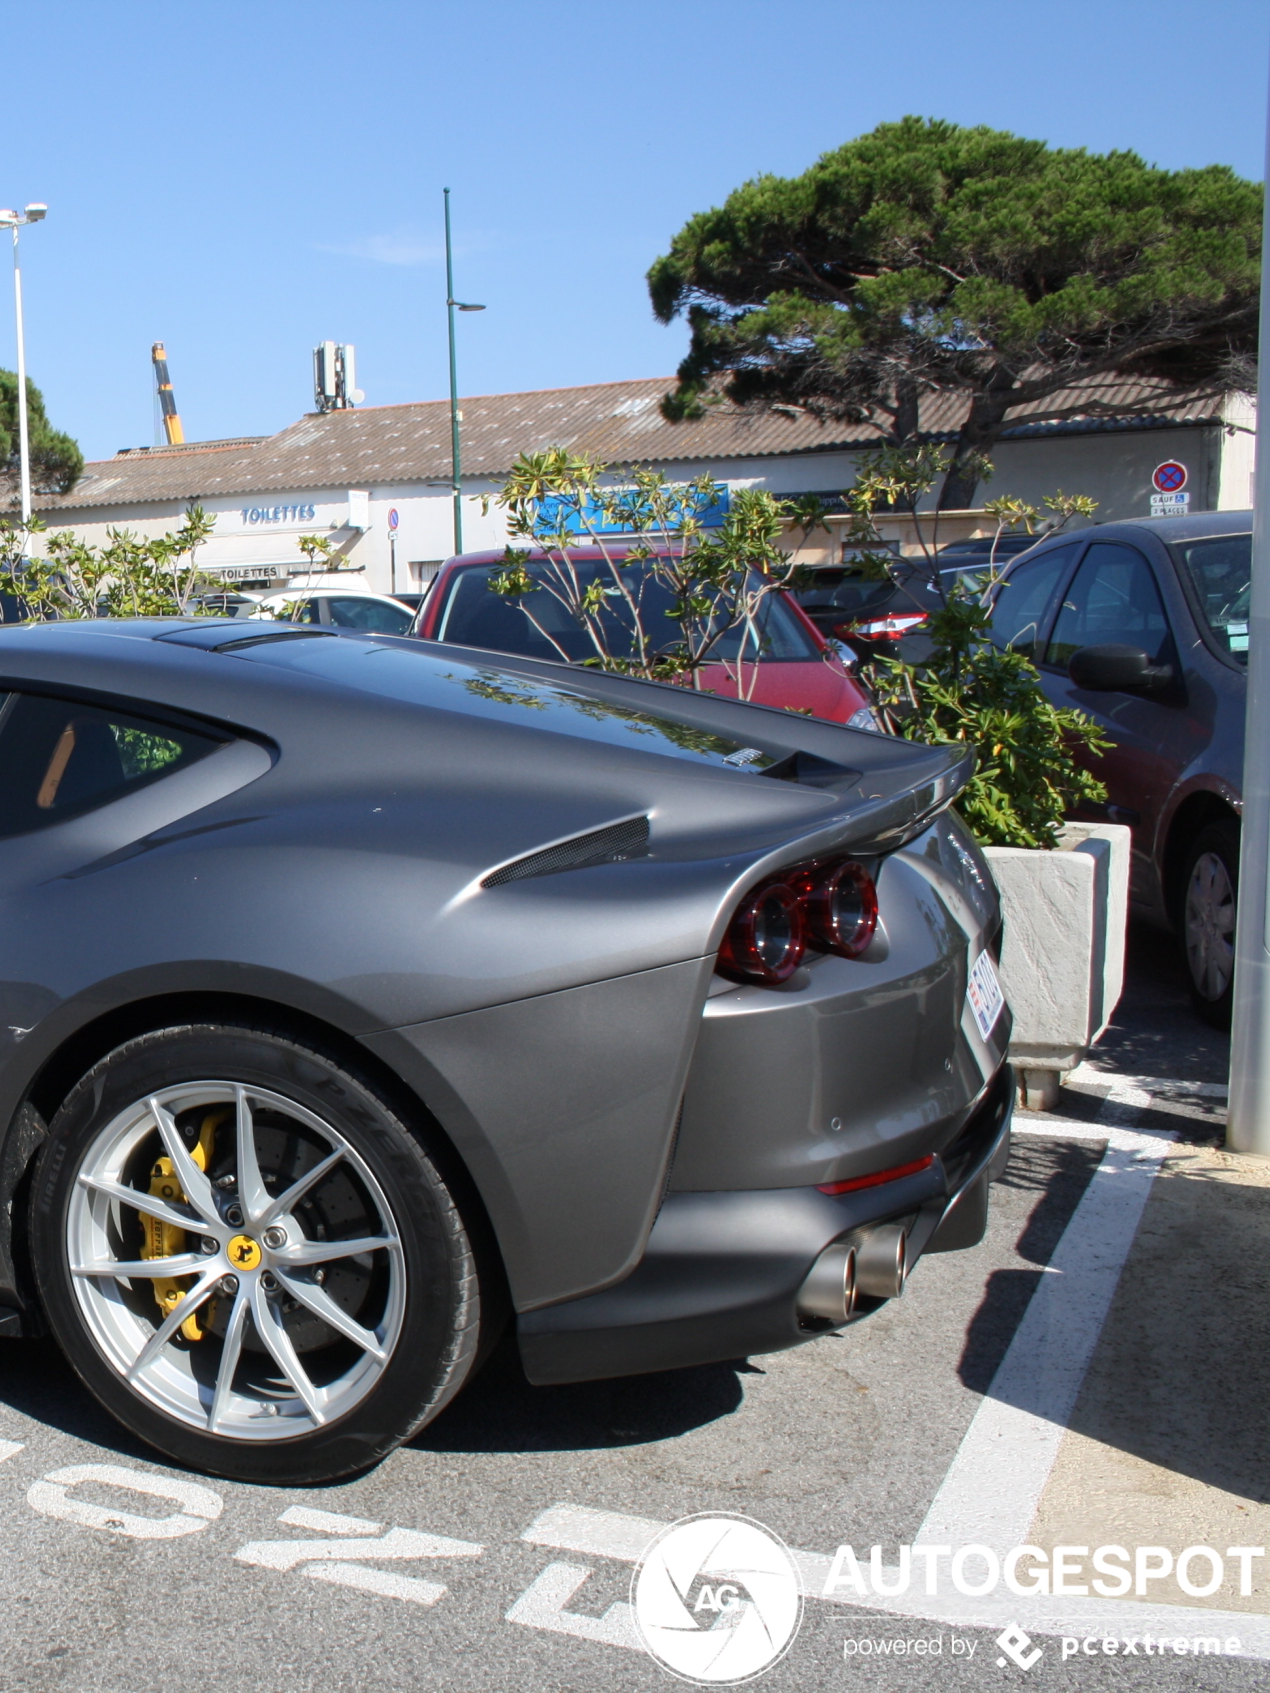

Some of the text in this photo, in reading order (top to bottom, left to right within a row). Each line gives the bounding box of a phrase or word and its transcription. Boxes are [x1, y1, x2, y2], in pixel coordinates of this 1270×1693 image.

[1152, 496, 1174, 504] SAUF
[241, 504, 316, 523] TOILETTES
[1159, 507, 1185, 515] PLACES
[220, 566, 277, 579] TOILETTES
[153, 1220, 164, 1259] Ferrar
